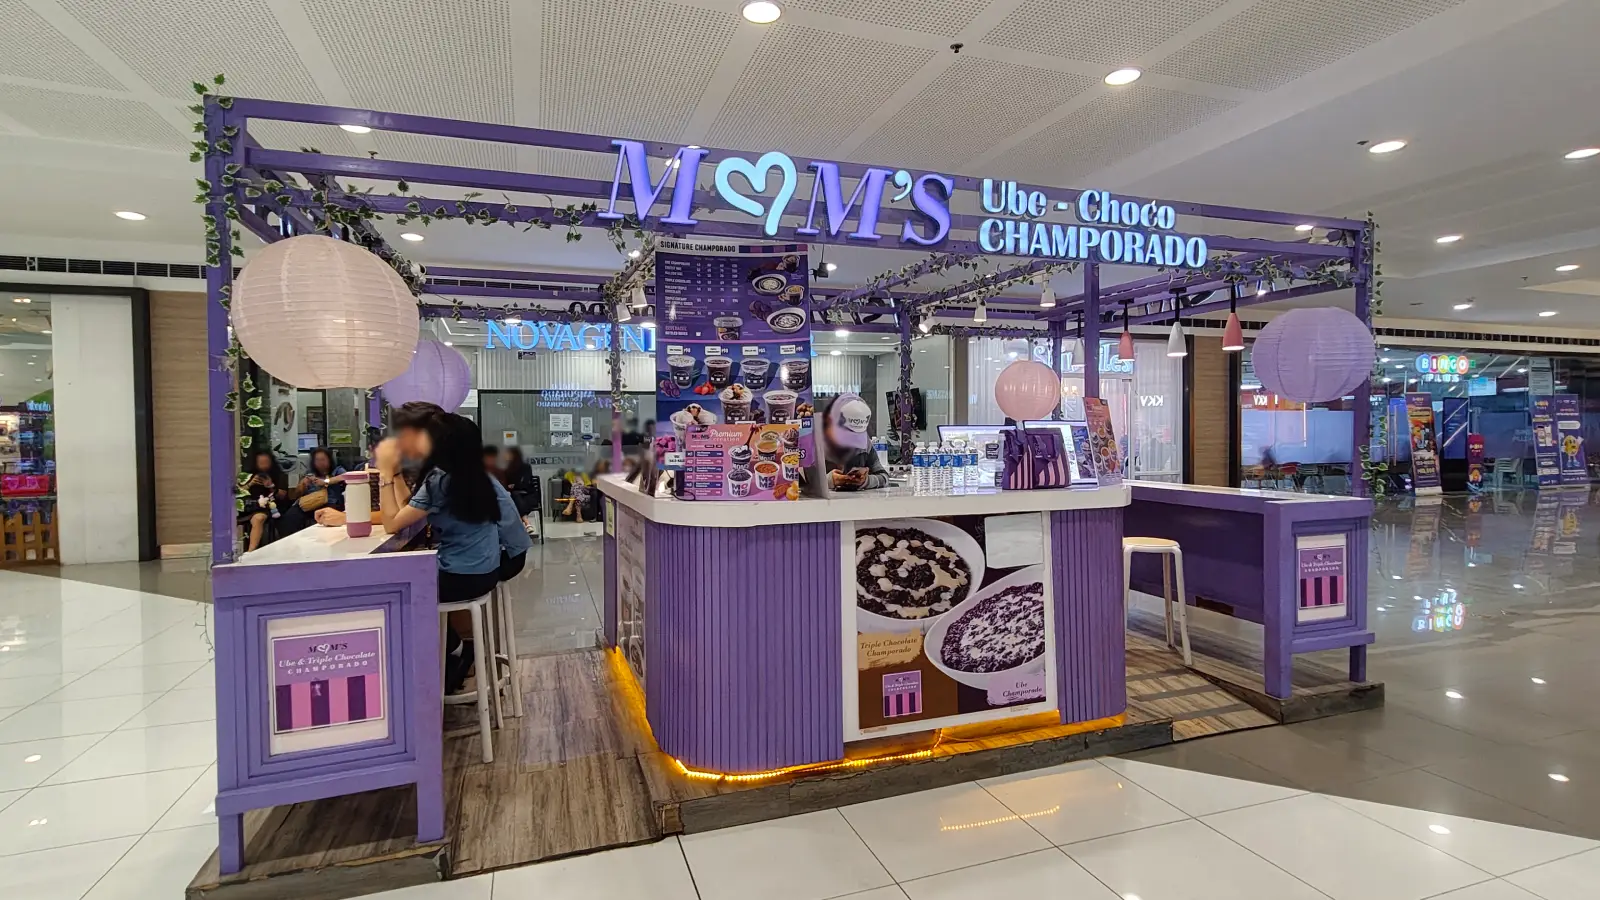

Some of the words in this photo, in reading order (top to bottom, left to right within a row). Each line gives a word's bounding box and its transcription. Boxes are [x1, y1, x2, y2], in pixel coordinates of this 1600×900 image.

[981, 178, 1047, 218] Ube
[1077, 189, 1177, 229] Choco
[660, 241, 694, 251] SIGNATURE
[695, 244, 736, 252] CHAMPORADO
[979, 218, 1208, 268] CHAMPORADO
[1418, 356, 1468, 372] BINGO
[709, 428, 743, 438] Premium
[861, 641, 882, 650] Triple
[883, 637, 918, 647] Chocolate
[866, 645, 912, 657] Champorado
[279, 660, 296, 668] Ube
[298, 658, 304, 666] &
[308, 655, 333, 665] Triple
[334, 651, 375, 662] Chocolate
[287, 660, 368, 675] CHAMPORADO
[1002, 685, 1043, 697] Champorado
